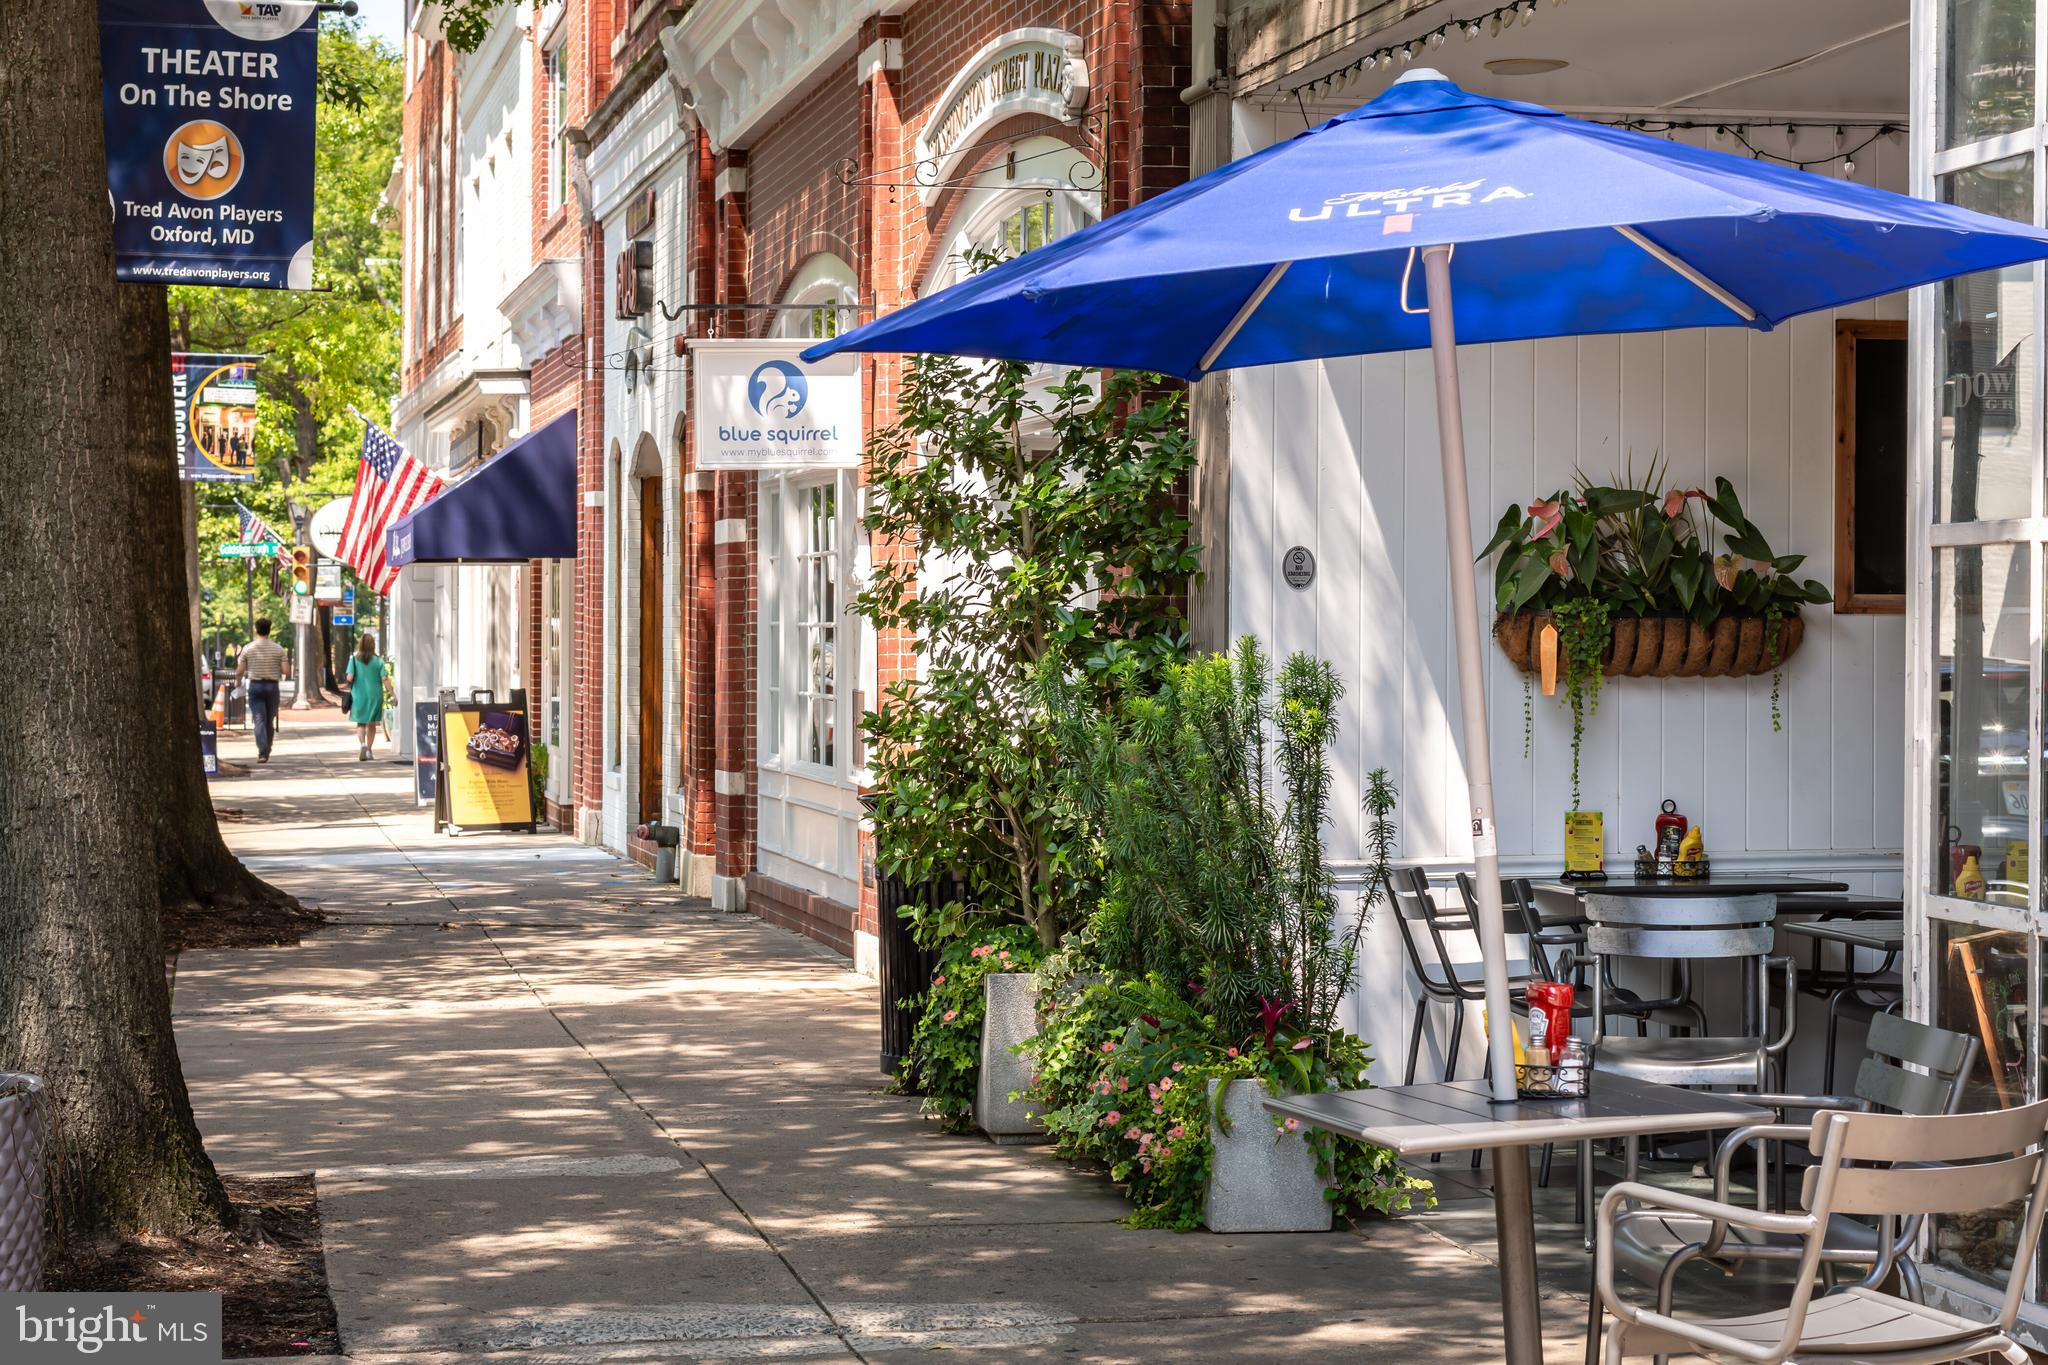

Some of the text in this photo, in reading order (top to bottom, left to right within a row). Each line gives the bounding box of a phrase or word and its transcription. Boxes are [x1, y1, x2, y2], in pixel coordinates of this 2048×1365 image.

[256, 3, 281, 16] TAP
[141, 47, 279, 79] THEATER
[991, 52, 1028, 102] STREET
[119, 82, 293, 111] On The Shore
[123, 200, 283, 225] Tred Avon Players
[1288, 185, 1528, 222] ULTRA
[150, 225, 254, 246] Oxford, MD
[132, 265, 271, 282] www.tredavonplayers.org
[718, 425, 839, 445] blue squirrel
[720, 447, 838, 458] www.mybluesquirrel.com
